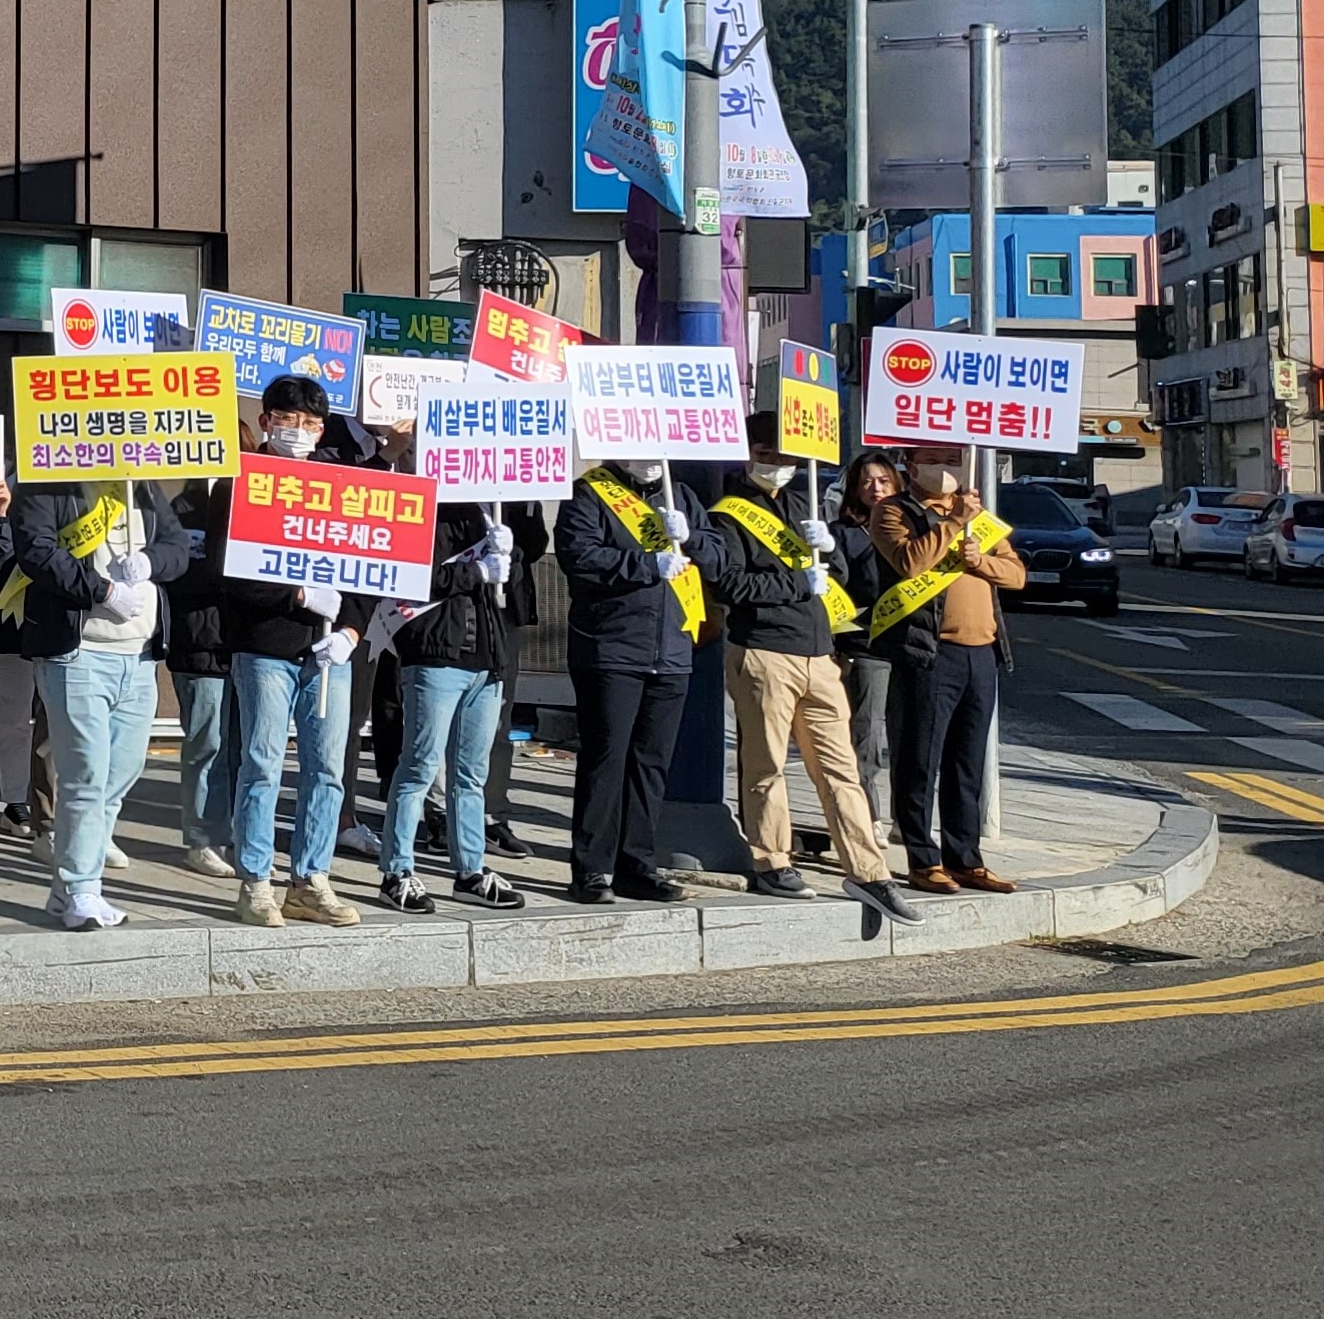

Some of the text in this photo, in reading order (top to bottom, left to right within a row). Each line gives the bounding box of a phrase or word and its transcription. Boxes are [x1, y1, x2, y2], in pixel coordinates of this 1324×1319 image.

[66, 316, 96, 332] STOP
[102, 312, 181, 346] 사람이 보이면
[208, 305, 256, 336] 교차로
[259, 315, 322, 350] 꼬리물기
[487, 308, 552, 355] 멈추고
[205, 333, 287, 366] 우리모두 함께
[889, 355, 931, 372] STOP
[29, 366, 222, 401] 횡단보도 이용
[578, 362, 734, 399] 세살부터 배운질서
[940, 351, 1070, 394] 사람이 보이면
[39, 409, 214, 437] 나의 생명을 지키는
[425, 398, 567, 437] 세살부터 배운질서
[584, 407, 740, 444] 여든까지 교통안전
[894, 394, 1052, 441] 일단 멈춤!!
[32, 440, 225, 469] 최소한의 약속입니다
[425, 447, 567, 484] 여든까지 교통안전
[247, 472, 425, 524] 멈추고 살피고
[282, 515, 392, 552] 건너주세요
[259, 549, 398, 592] 고맙습니다!
